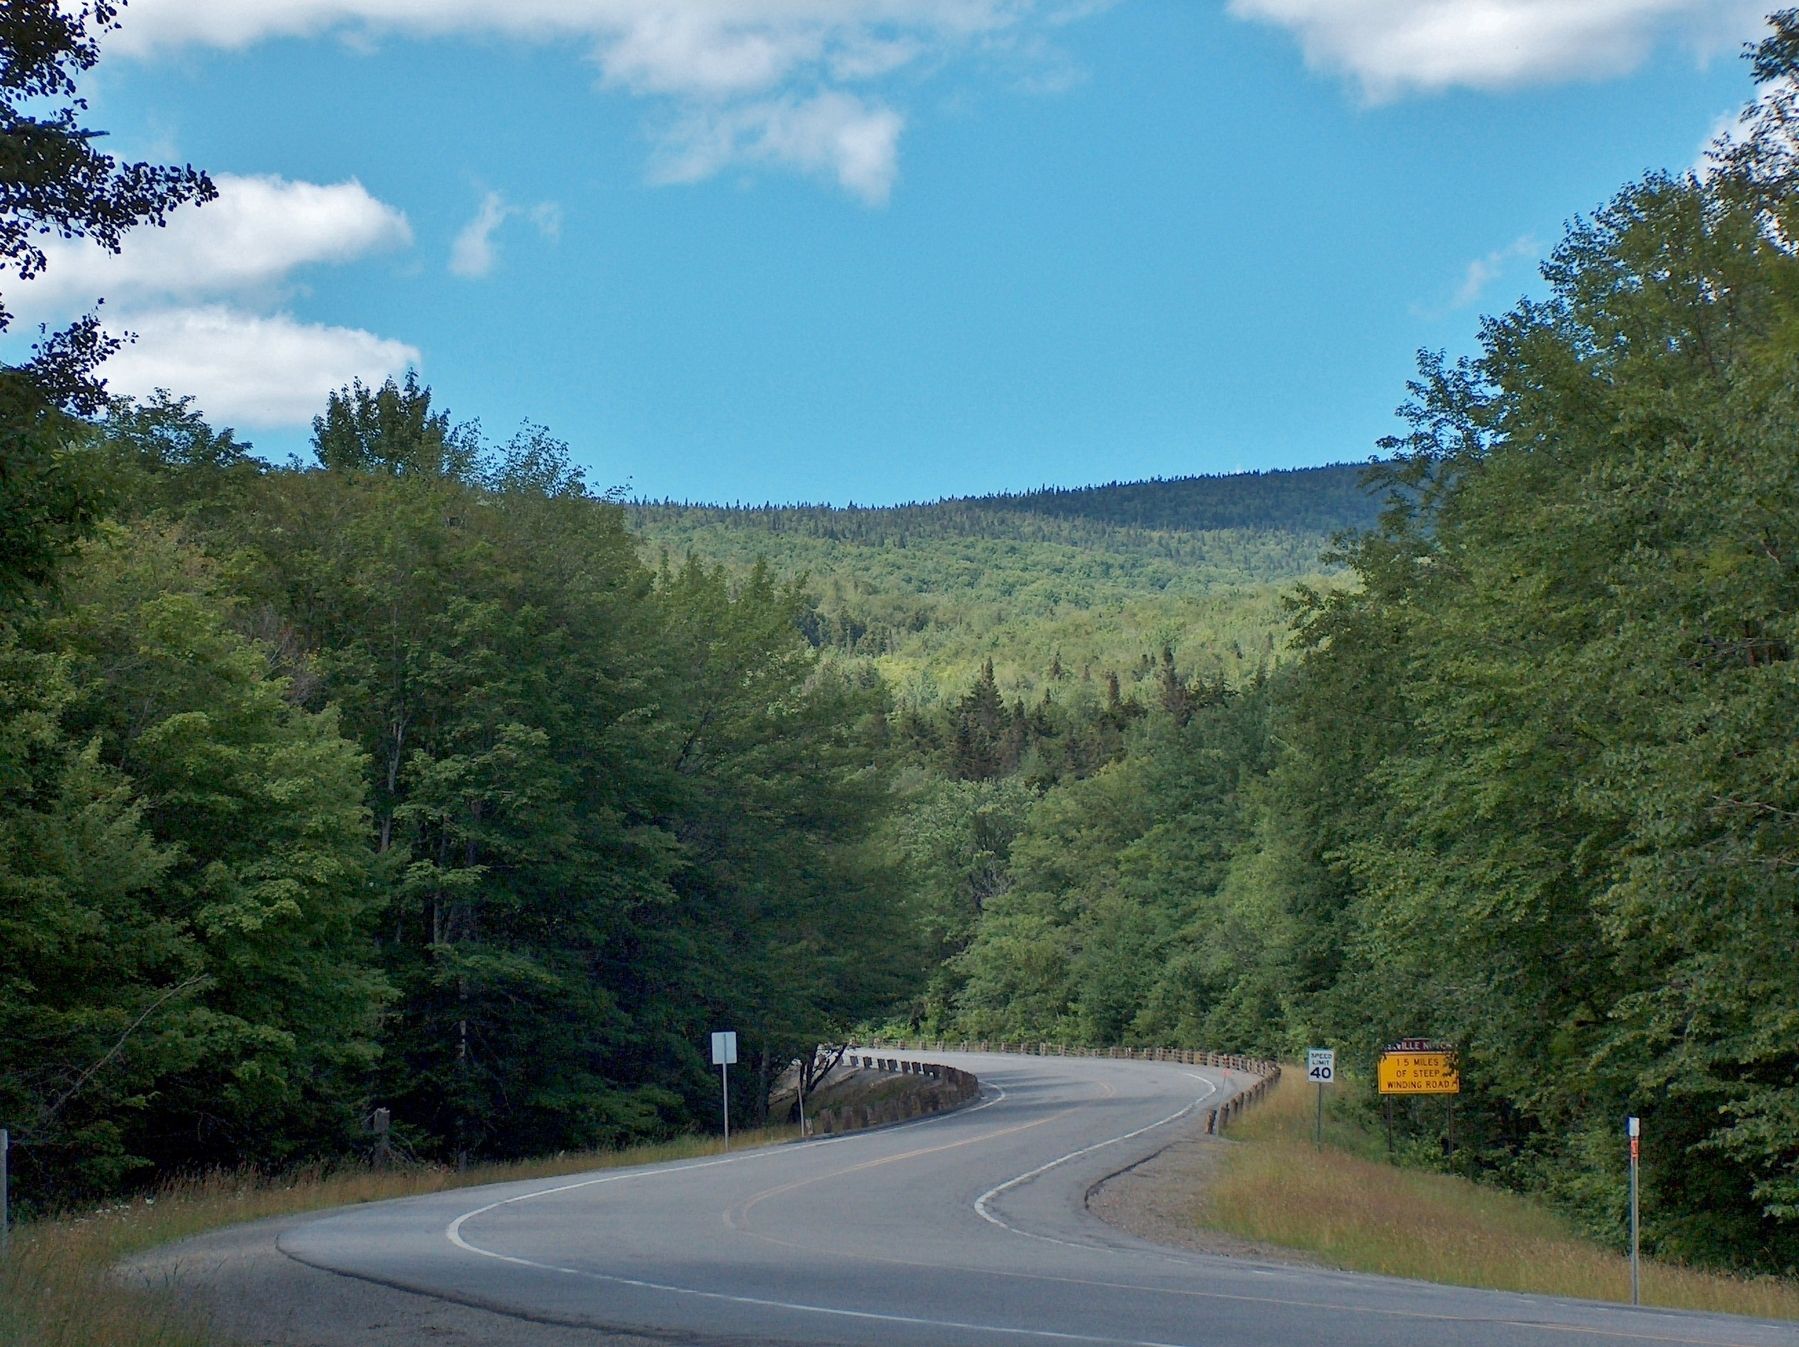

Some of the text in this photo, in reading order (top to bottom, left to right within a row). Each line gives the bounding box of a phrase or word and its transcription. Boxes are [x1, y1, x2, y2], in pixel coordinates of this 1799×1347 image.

[1413, 1059, 1439, 1067] MILES
[1310, 1067, 1331, 1079] 40
[1396, 1070, 1440, 1078] OF STEEP
[1387, 1081, 1422, 1089] WINDING
